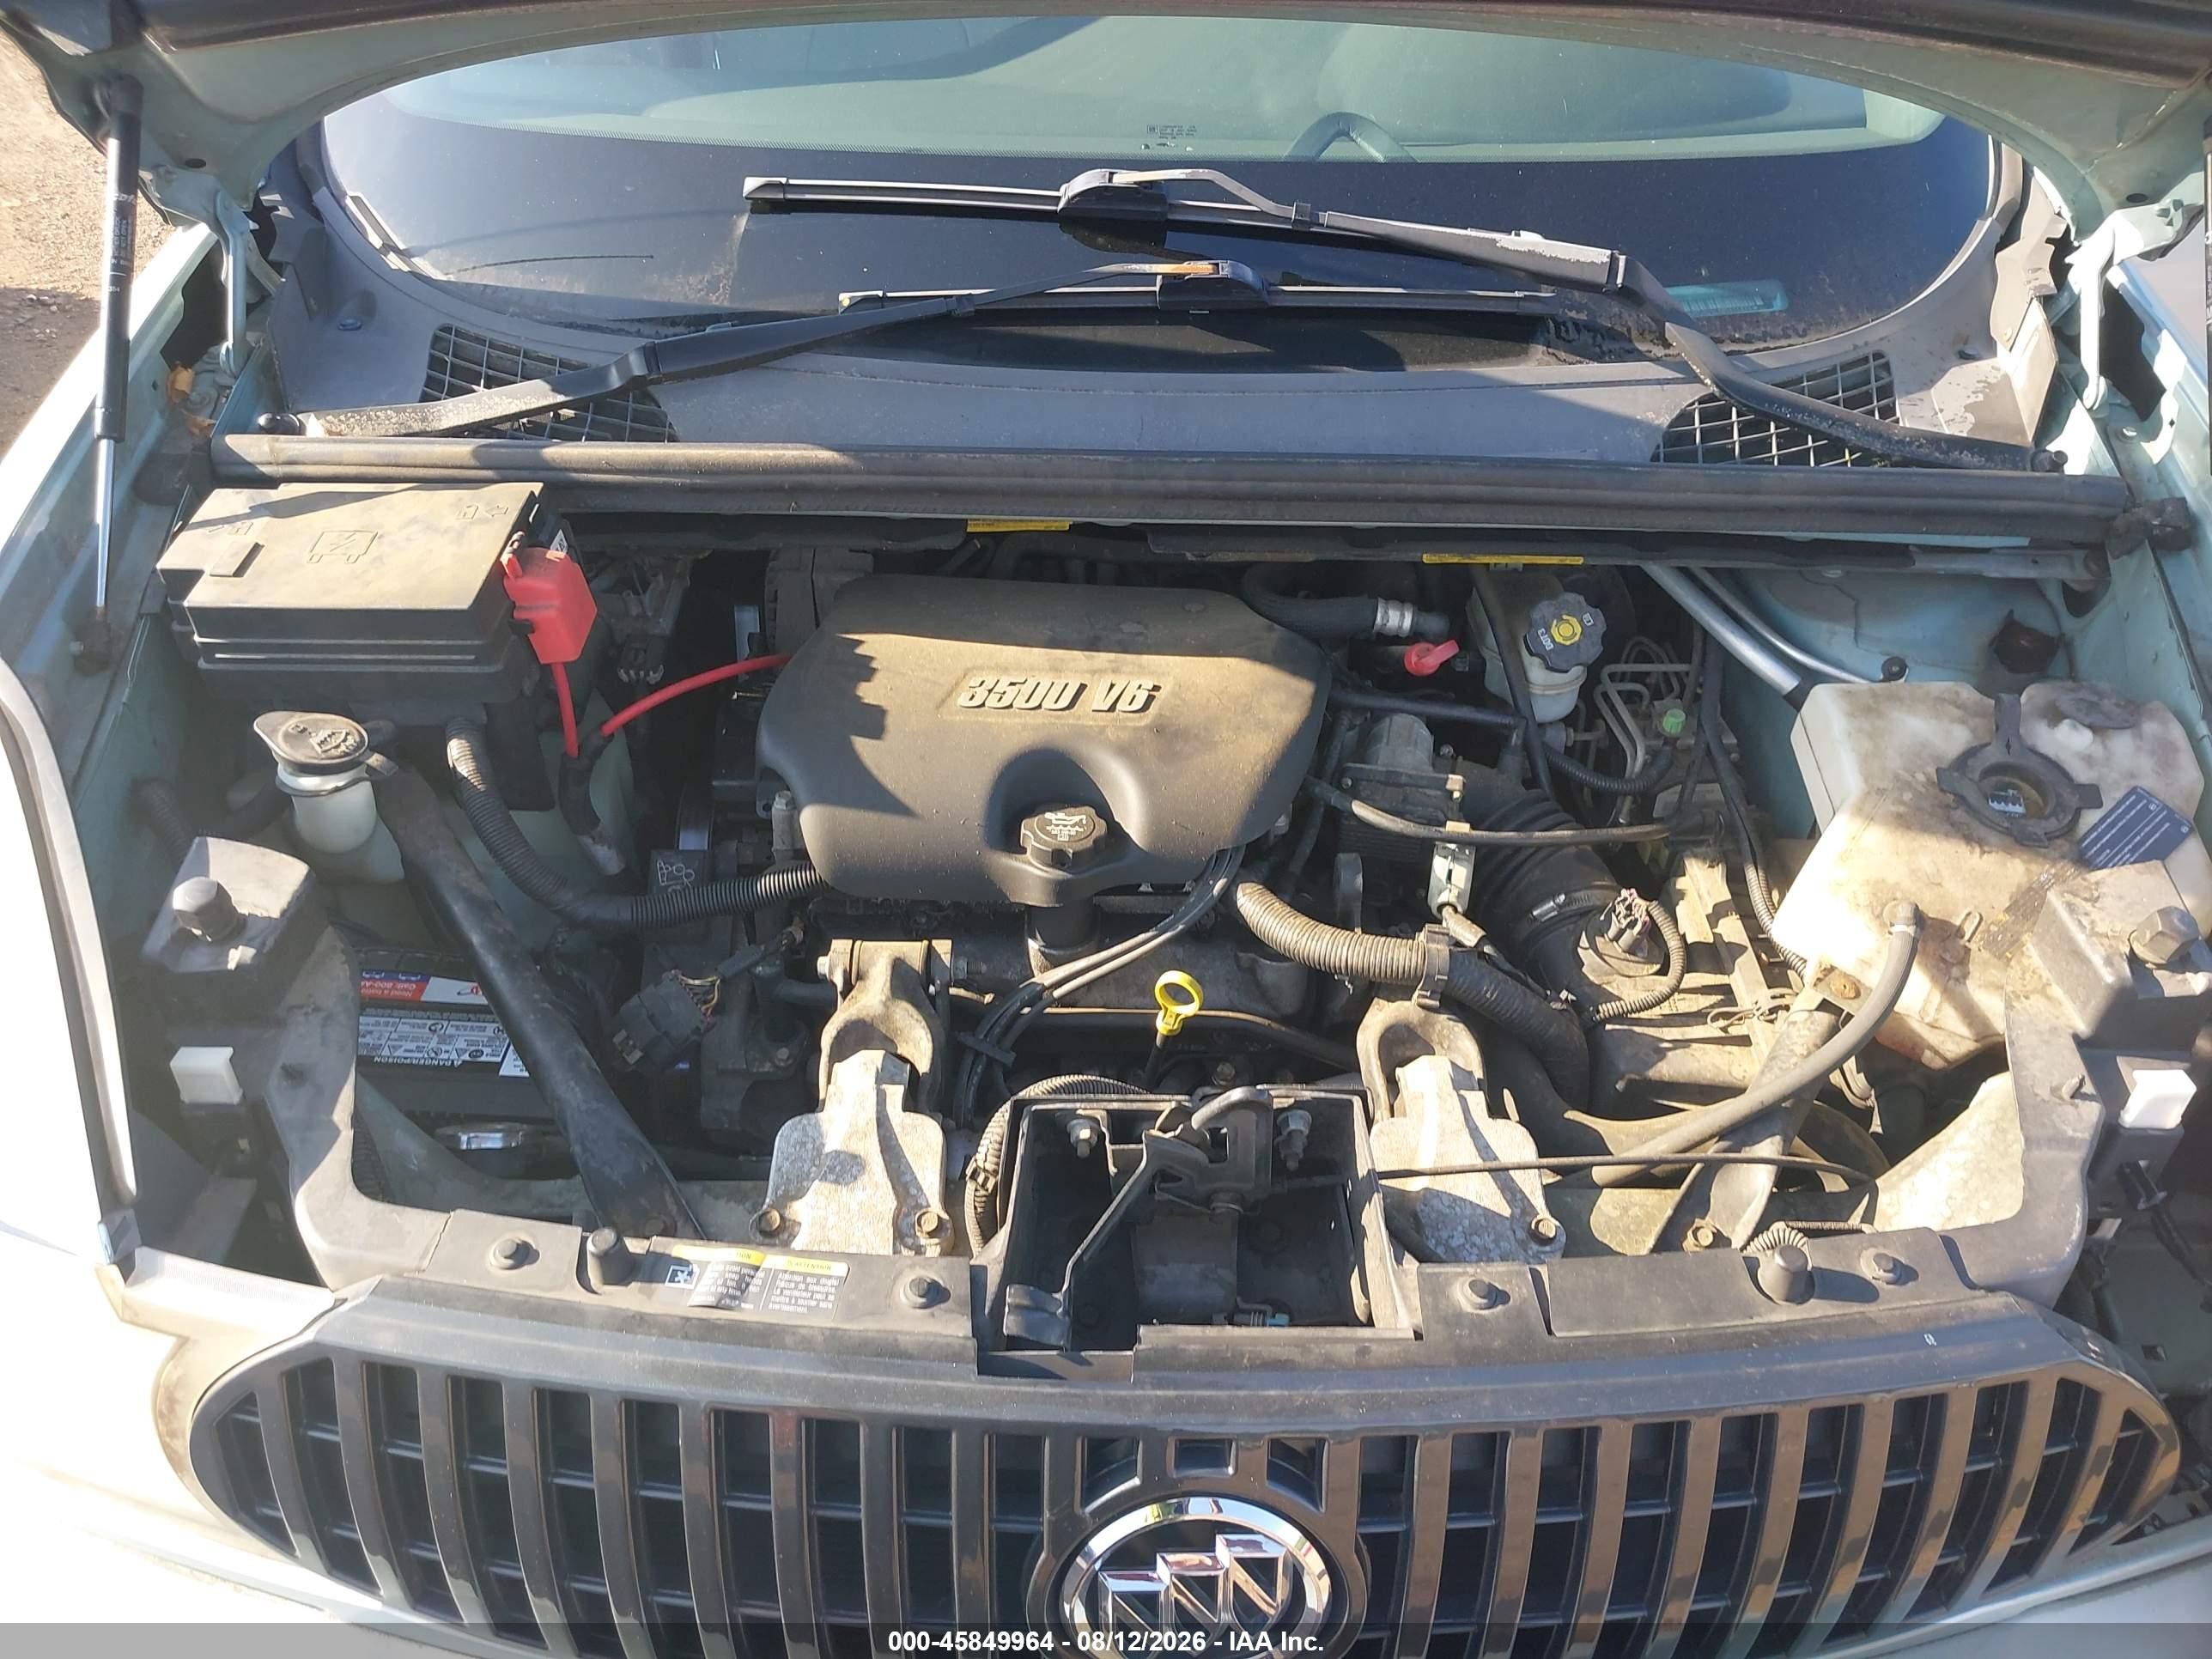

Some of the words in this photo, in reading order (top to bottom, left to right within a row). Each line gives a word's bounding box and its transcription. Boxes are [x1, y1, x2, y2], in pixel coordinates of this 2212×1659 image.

[679, 628, 695, 651] DOT3
[957, 676, 1087, 711] 3500
[1092, 678, 1162, 714] V6
[793, 1261, 832, 1272] ATTENTION
